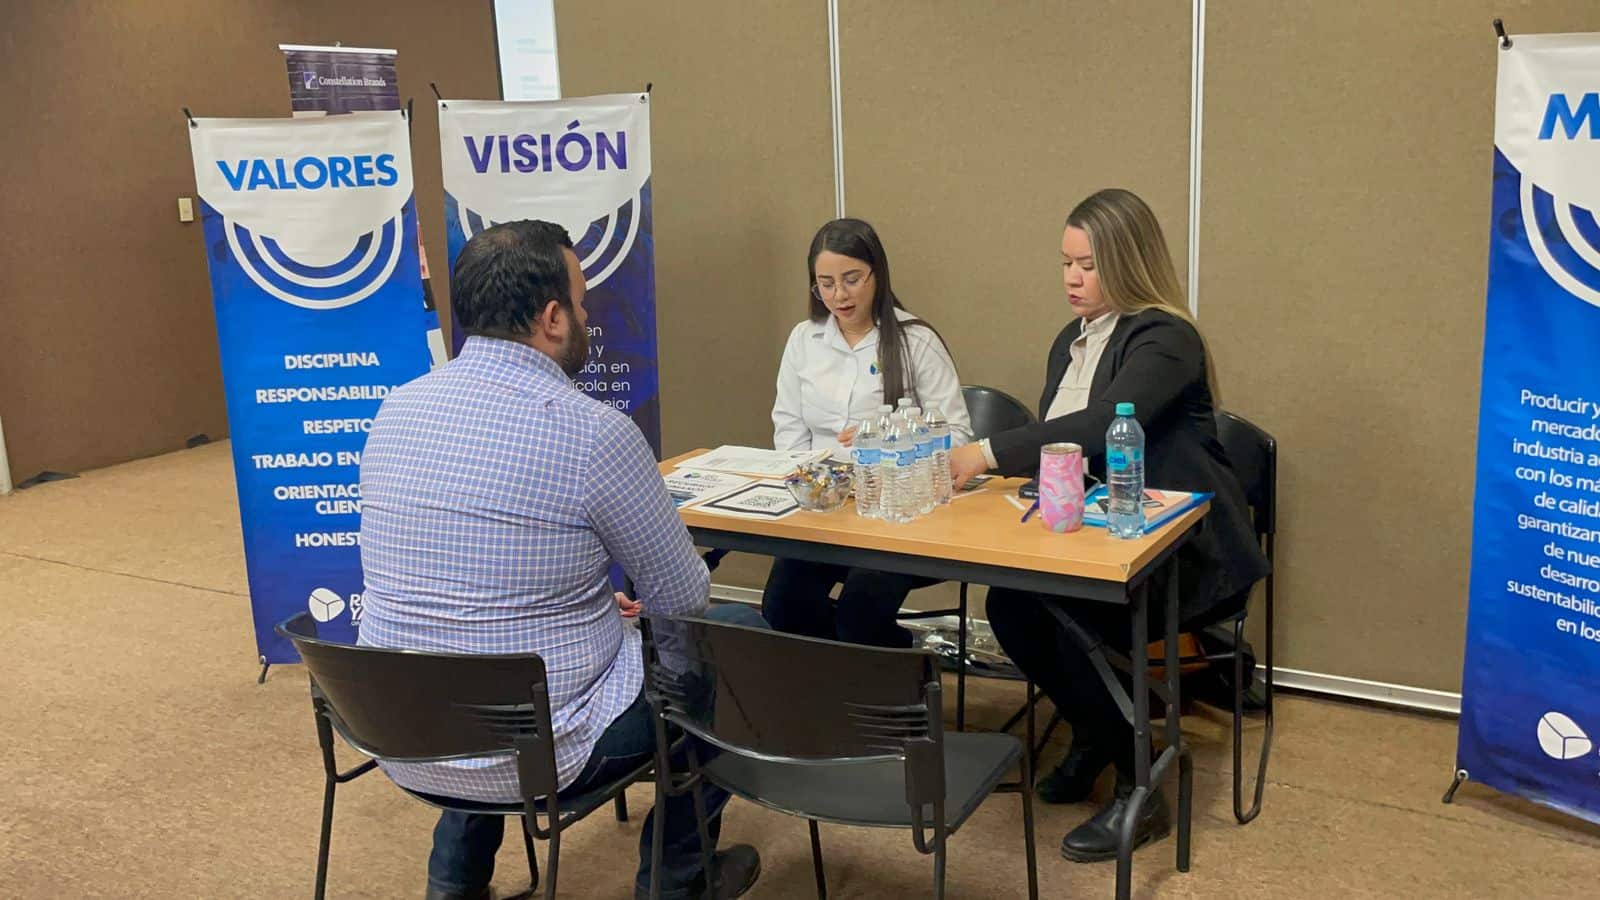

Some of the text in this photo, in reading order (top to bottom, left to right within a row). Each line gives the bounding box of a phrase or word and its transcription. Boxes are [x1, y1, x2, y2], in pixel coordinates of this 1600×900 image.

[319, 76, 386, 88] Constellation Brands
[463, 119, 628, 174] VISIÓN
[216, 153, 398, 192] VALORES
[284, 352, 380, 370] DISCIPLINA
[595, 345, 604, 358] y
[611, 363, 630, 374] en
[611, 381, 630, 392] en
[1520, 388, 1590, 414] Producir
[303, 418, 375, 435] RESPETO
[252, 451, 361, 469] TRABAJO EN
[1512, 437, 1584, 465] industria
[1515, 466, 1546, 484] con
[1549, 468, 1574, 488] los
[1534, 491, 1600, 519] de calid
[1517, 513, 1600, 544] garantizan
[1543, 542, 1600, 569] de nue
[1540, 563, 1600, 593] desarro
[1556, 618, 1578, 636] en
